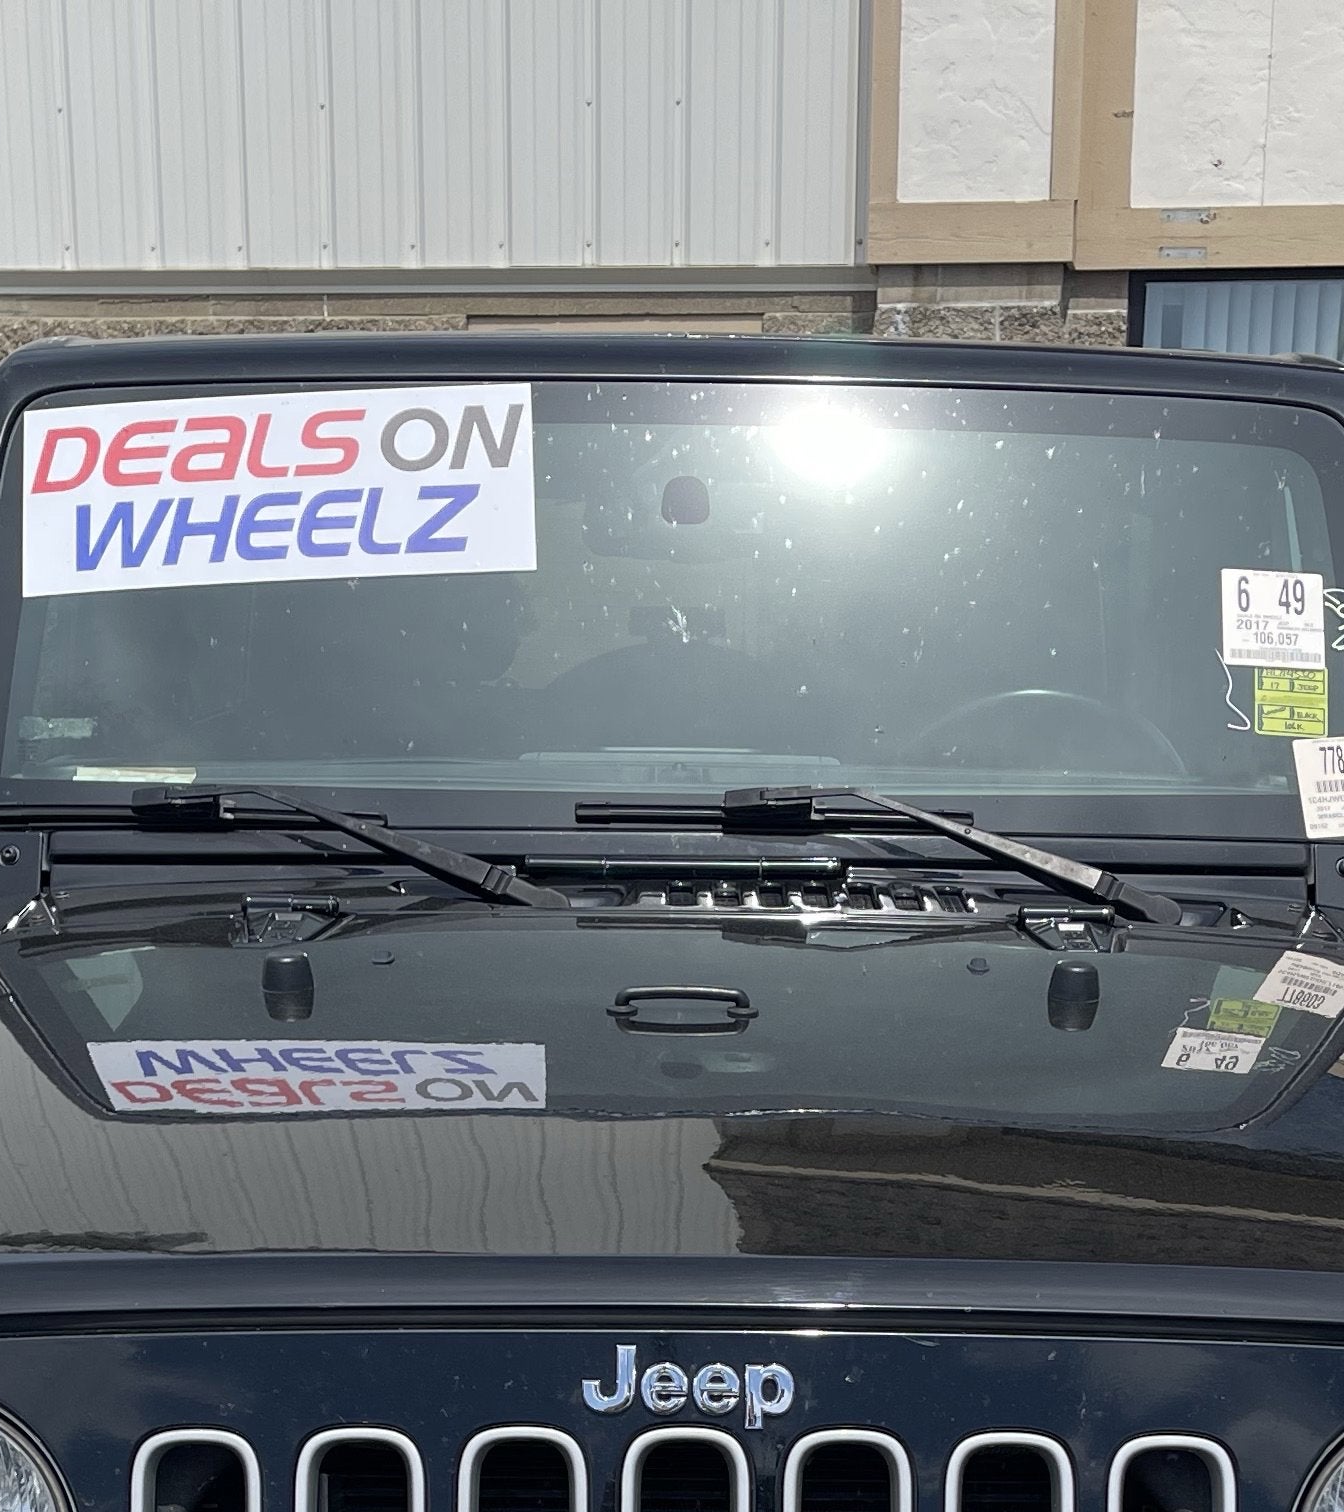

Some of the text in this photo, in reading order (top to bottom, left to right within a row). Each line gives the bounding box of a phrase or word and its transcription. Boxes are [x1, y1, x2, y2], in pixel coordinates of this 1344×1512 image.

[31, 403, 524, 494] DEALS ON
[75, 484, 481, 573] WHEELZ
[1236, 619, 1269, 631] 2017
[1238, 576, 1305, 615] 6 49
[582, 1344, 795, 1430] Jeep
